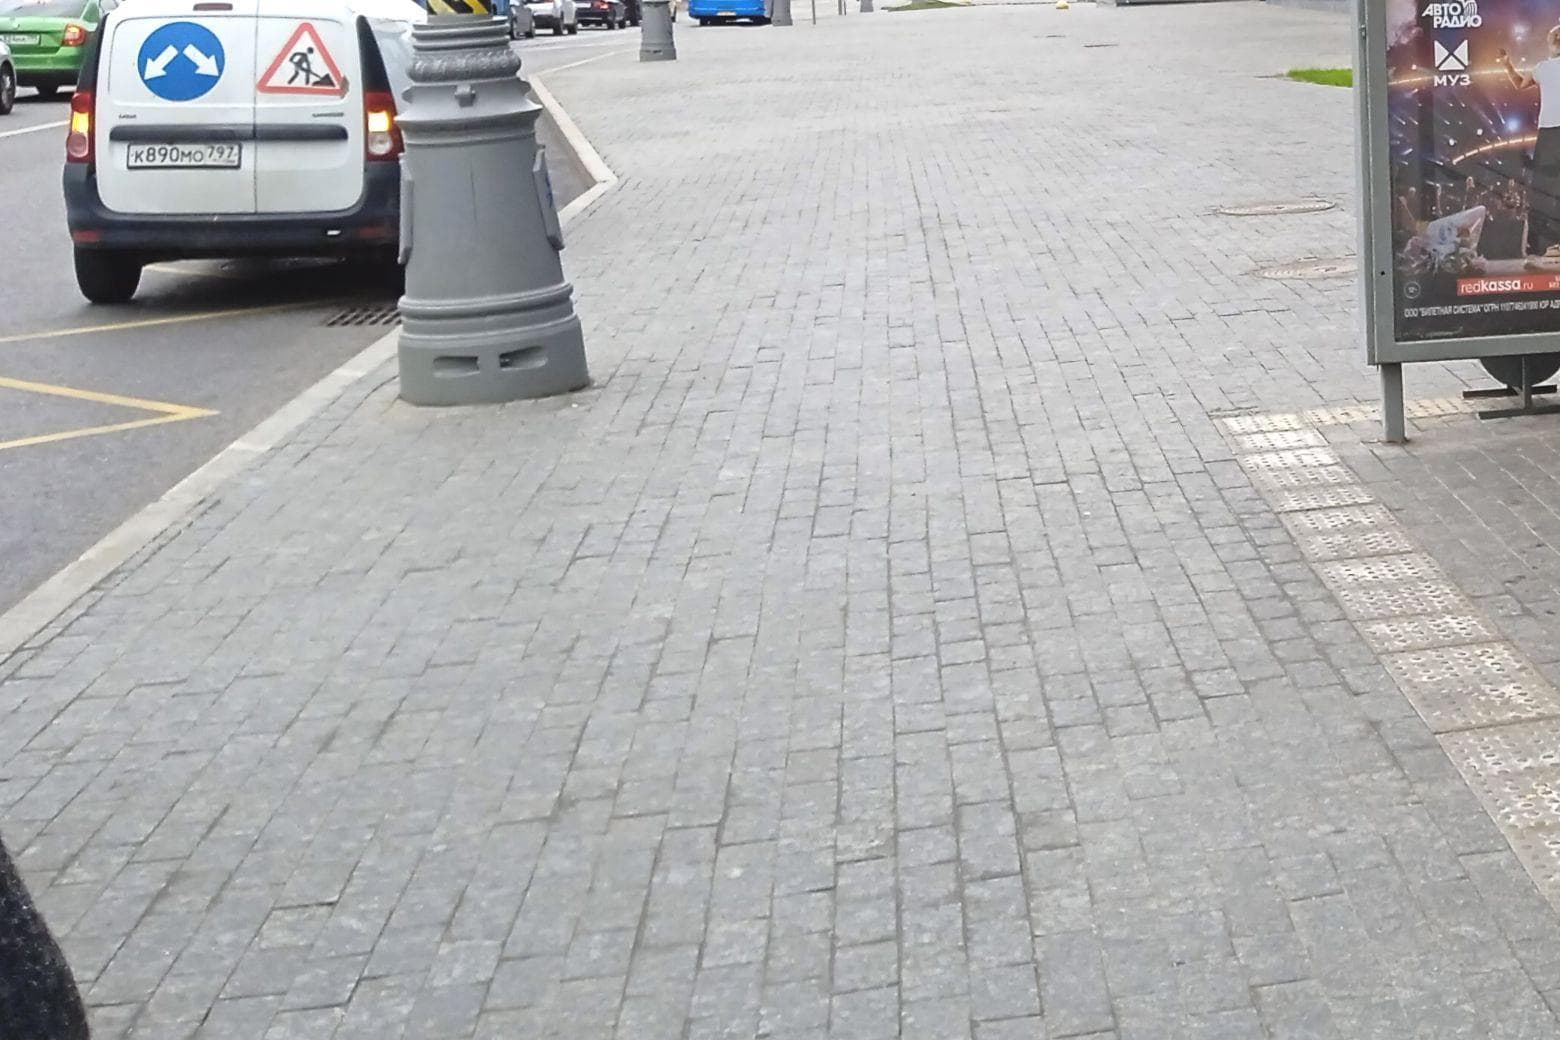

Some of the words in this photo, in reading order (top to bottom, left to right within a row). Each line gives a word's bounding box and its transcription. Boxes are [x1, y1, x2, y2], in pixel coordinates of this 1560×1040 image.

[1422, 3, 1461, 16] АВТО
[1433, 15, 1482, 28] РАДИО
[1434, 74, 1471, 87] МУЗ
[207, 146, 234, 159] 797
